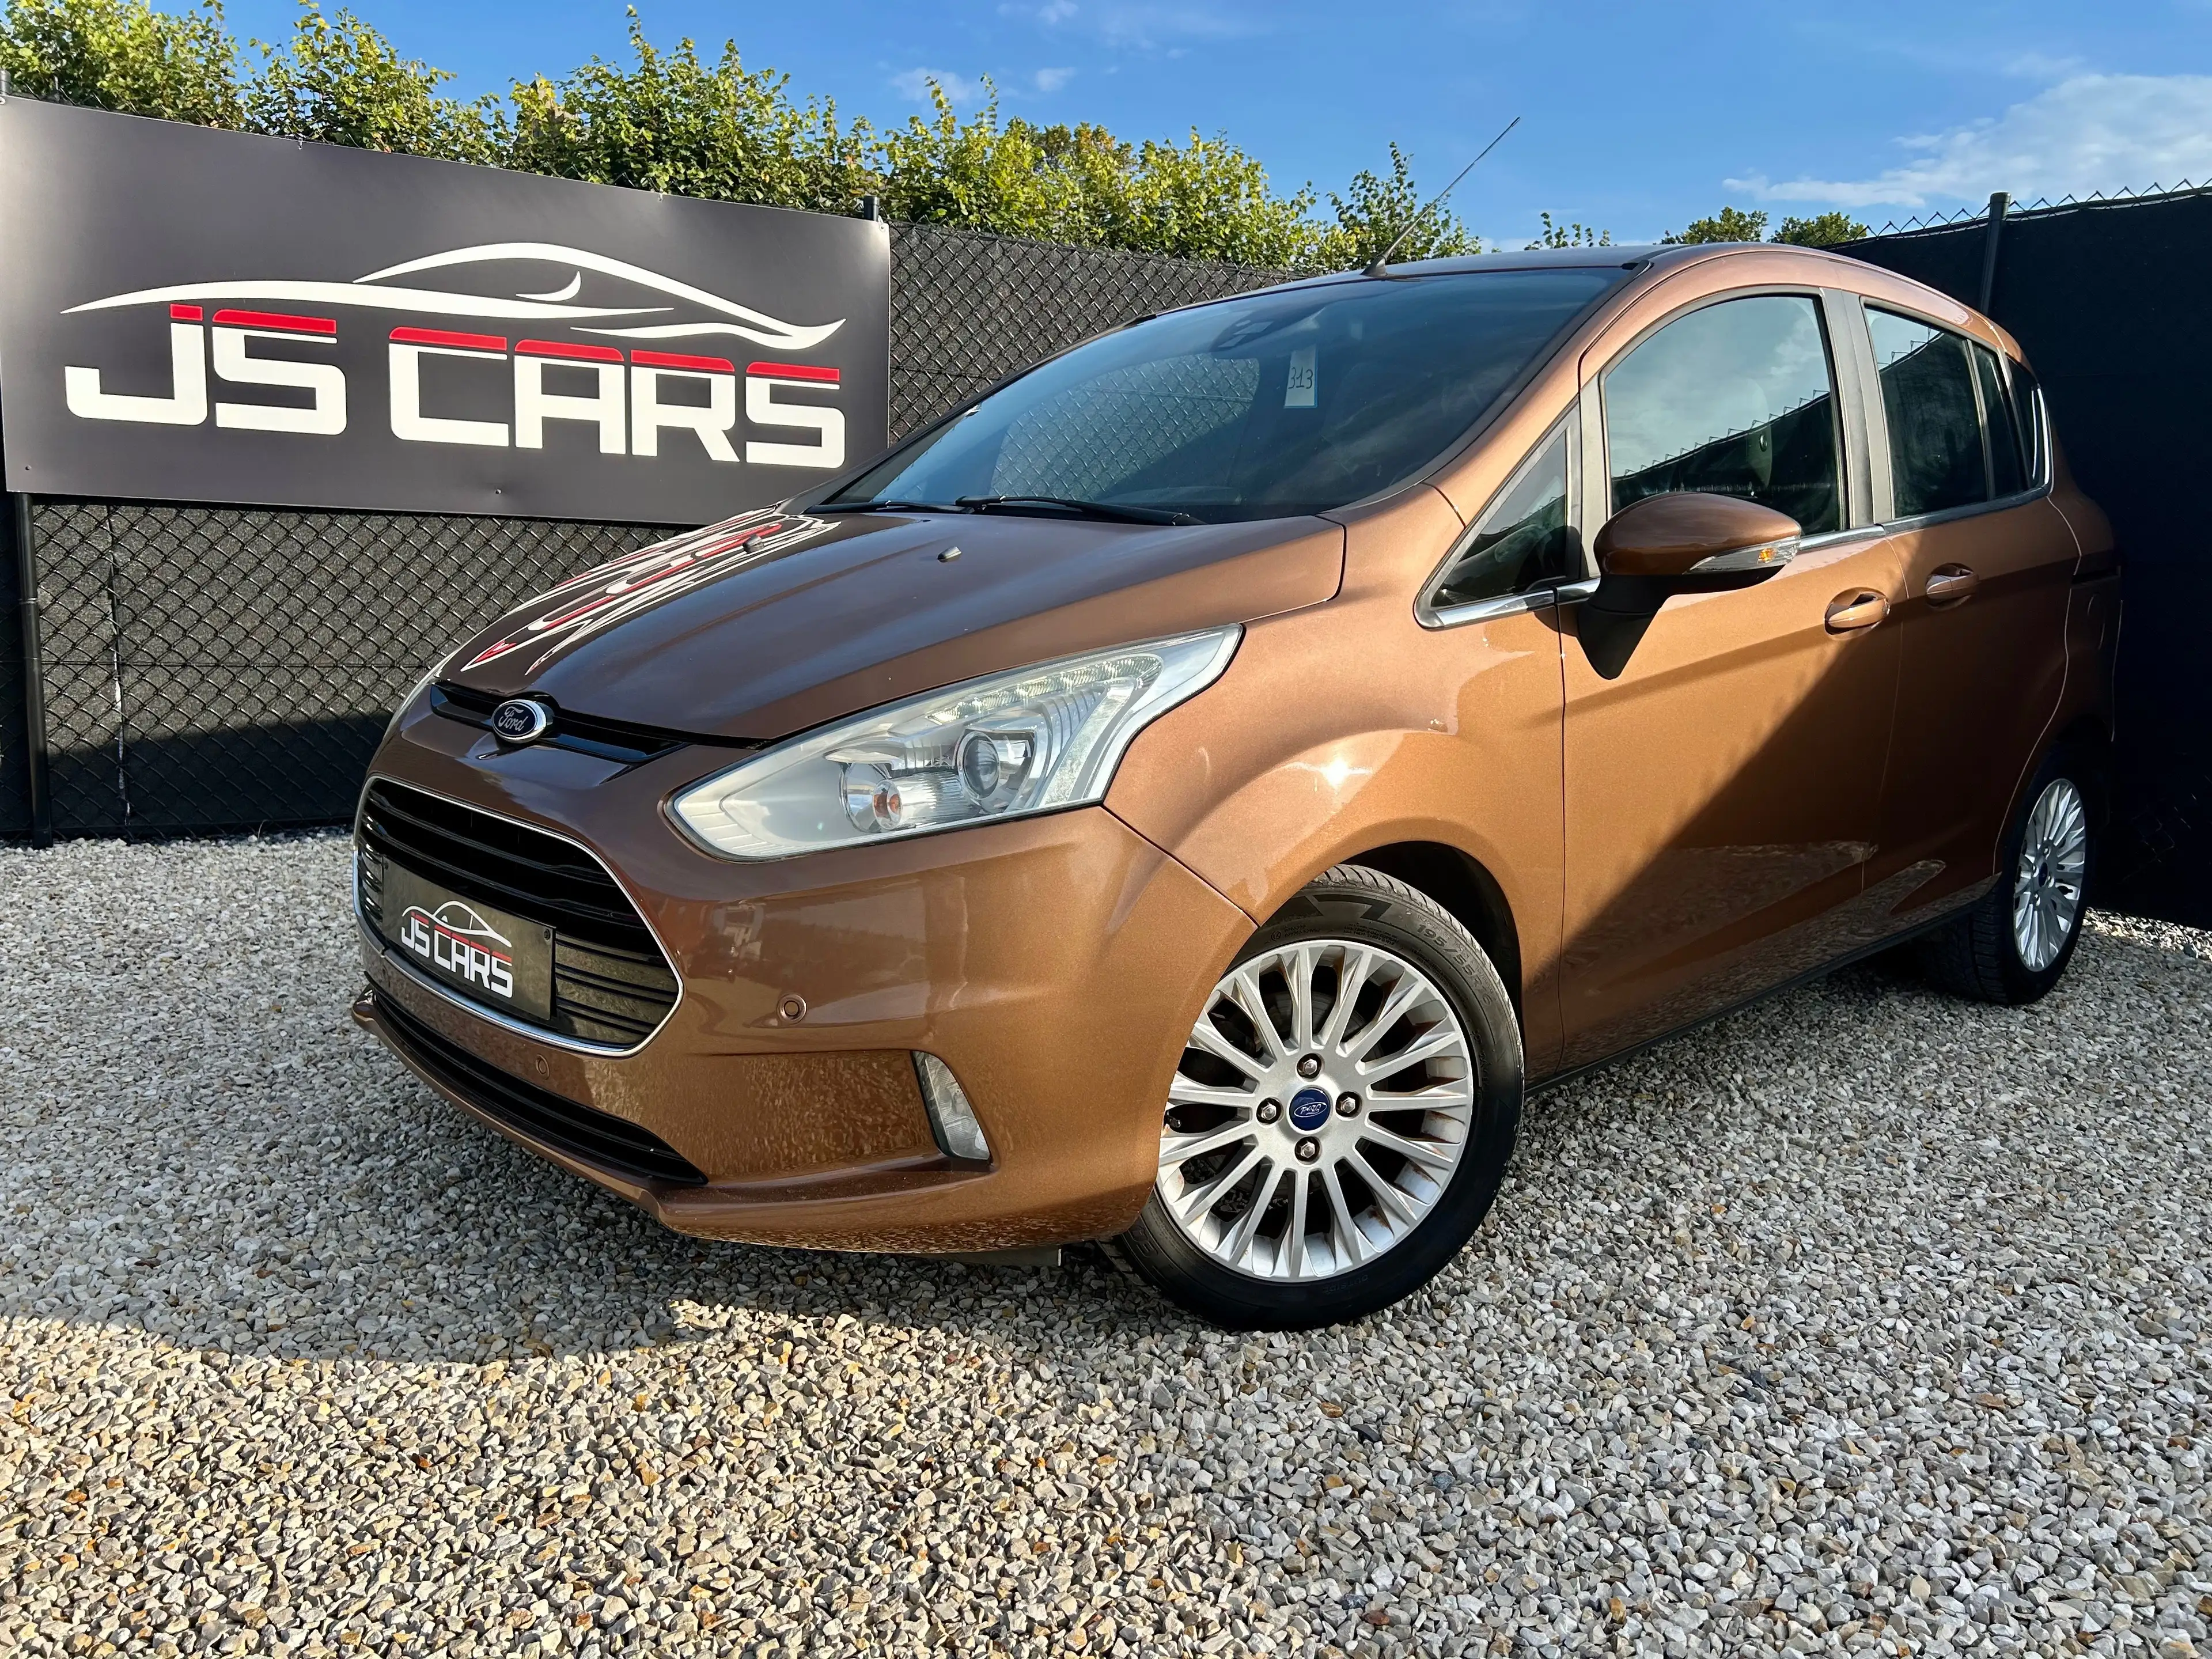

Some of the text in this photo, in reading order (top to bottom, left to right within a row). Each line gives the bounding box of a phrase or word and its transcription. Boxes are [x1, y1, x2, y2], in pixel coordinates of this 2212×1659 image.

[65, 303, 846, 468] JS CARS
[1288, 366, 1313, 389] 313
[498, 706, 529, 732] Ford
[401, 911, 513, 998] JS CARS
